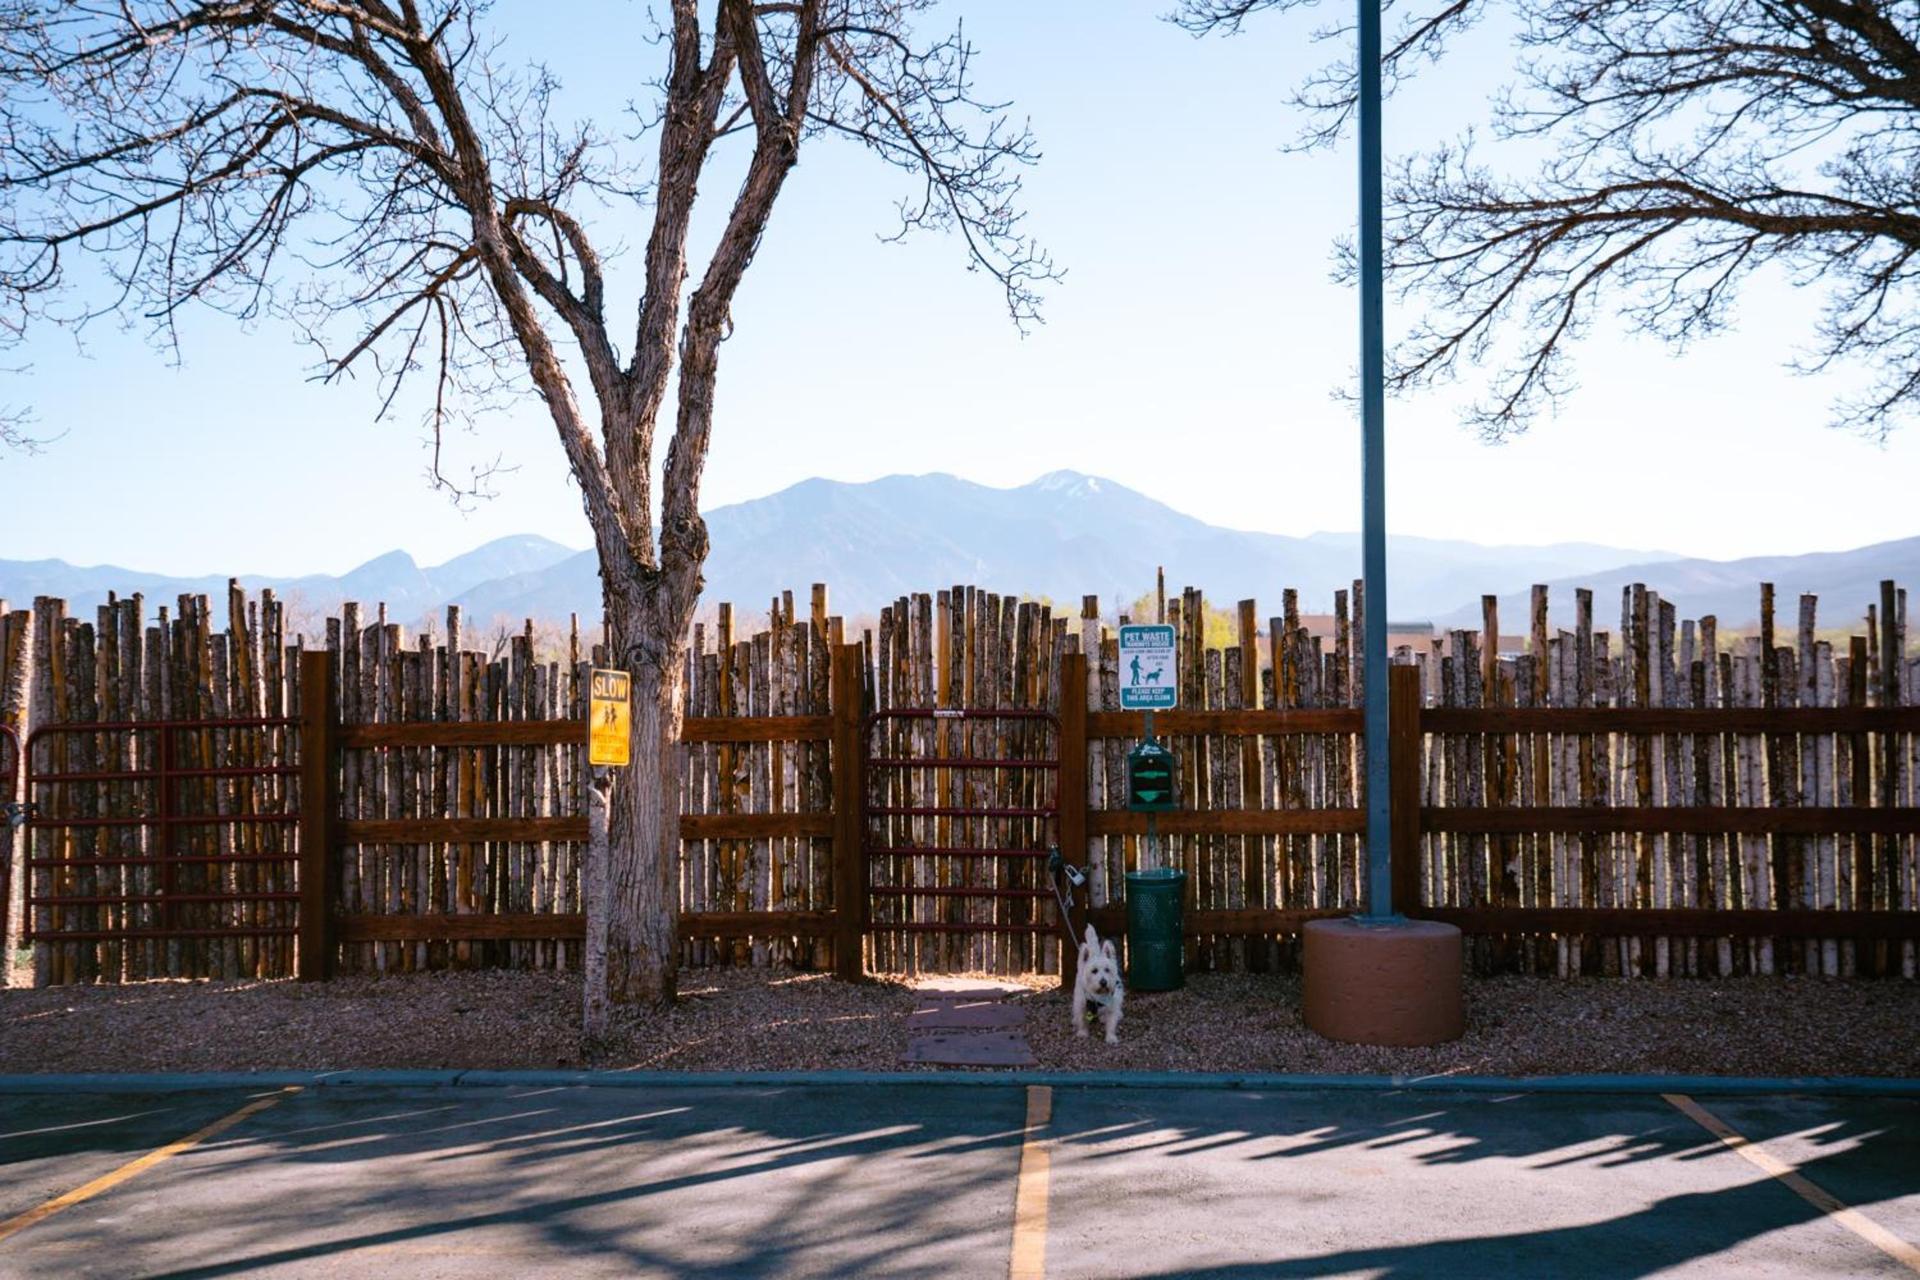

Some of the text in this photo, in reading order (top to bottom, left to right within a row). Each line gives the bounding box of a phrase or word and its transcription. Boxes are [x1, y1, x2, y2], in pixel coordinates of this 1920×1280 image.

[1124, 631, 1170, 641] PET WASTE
[594, 676, 627, 699] SLOW
[1131, 687, 1151, 695] PLEASE
